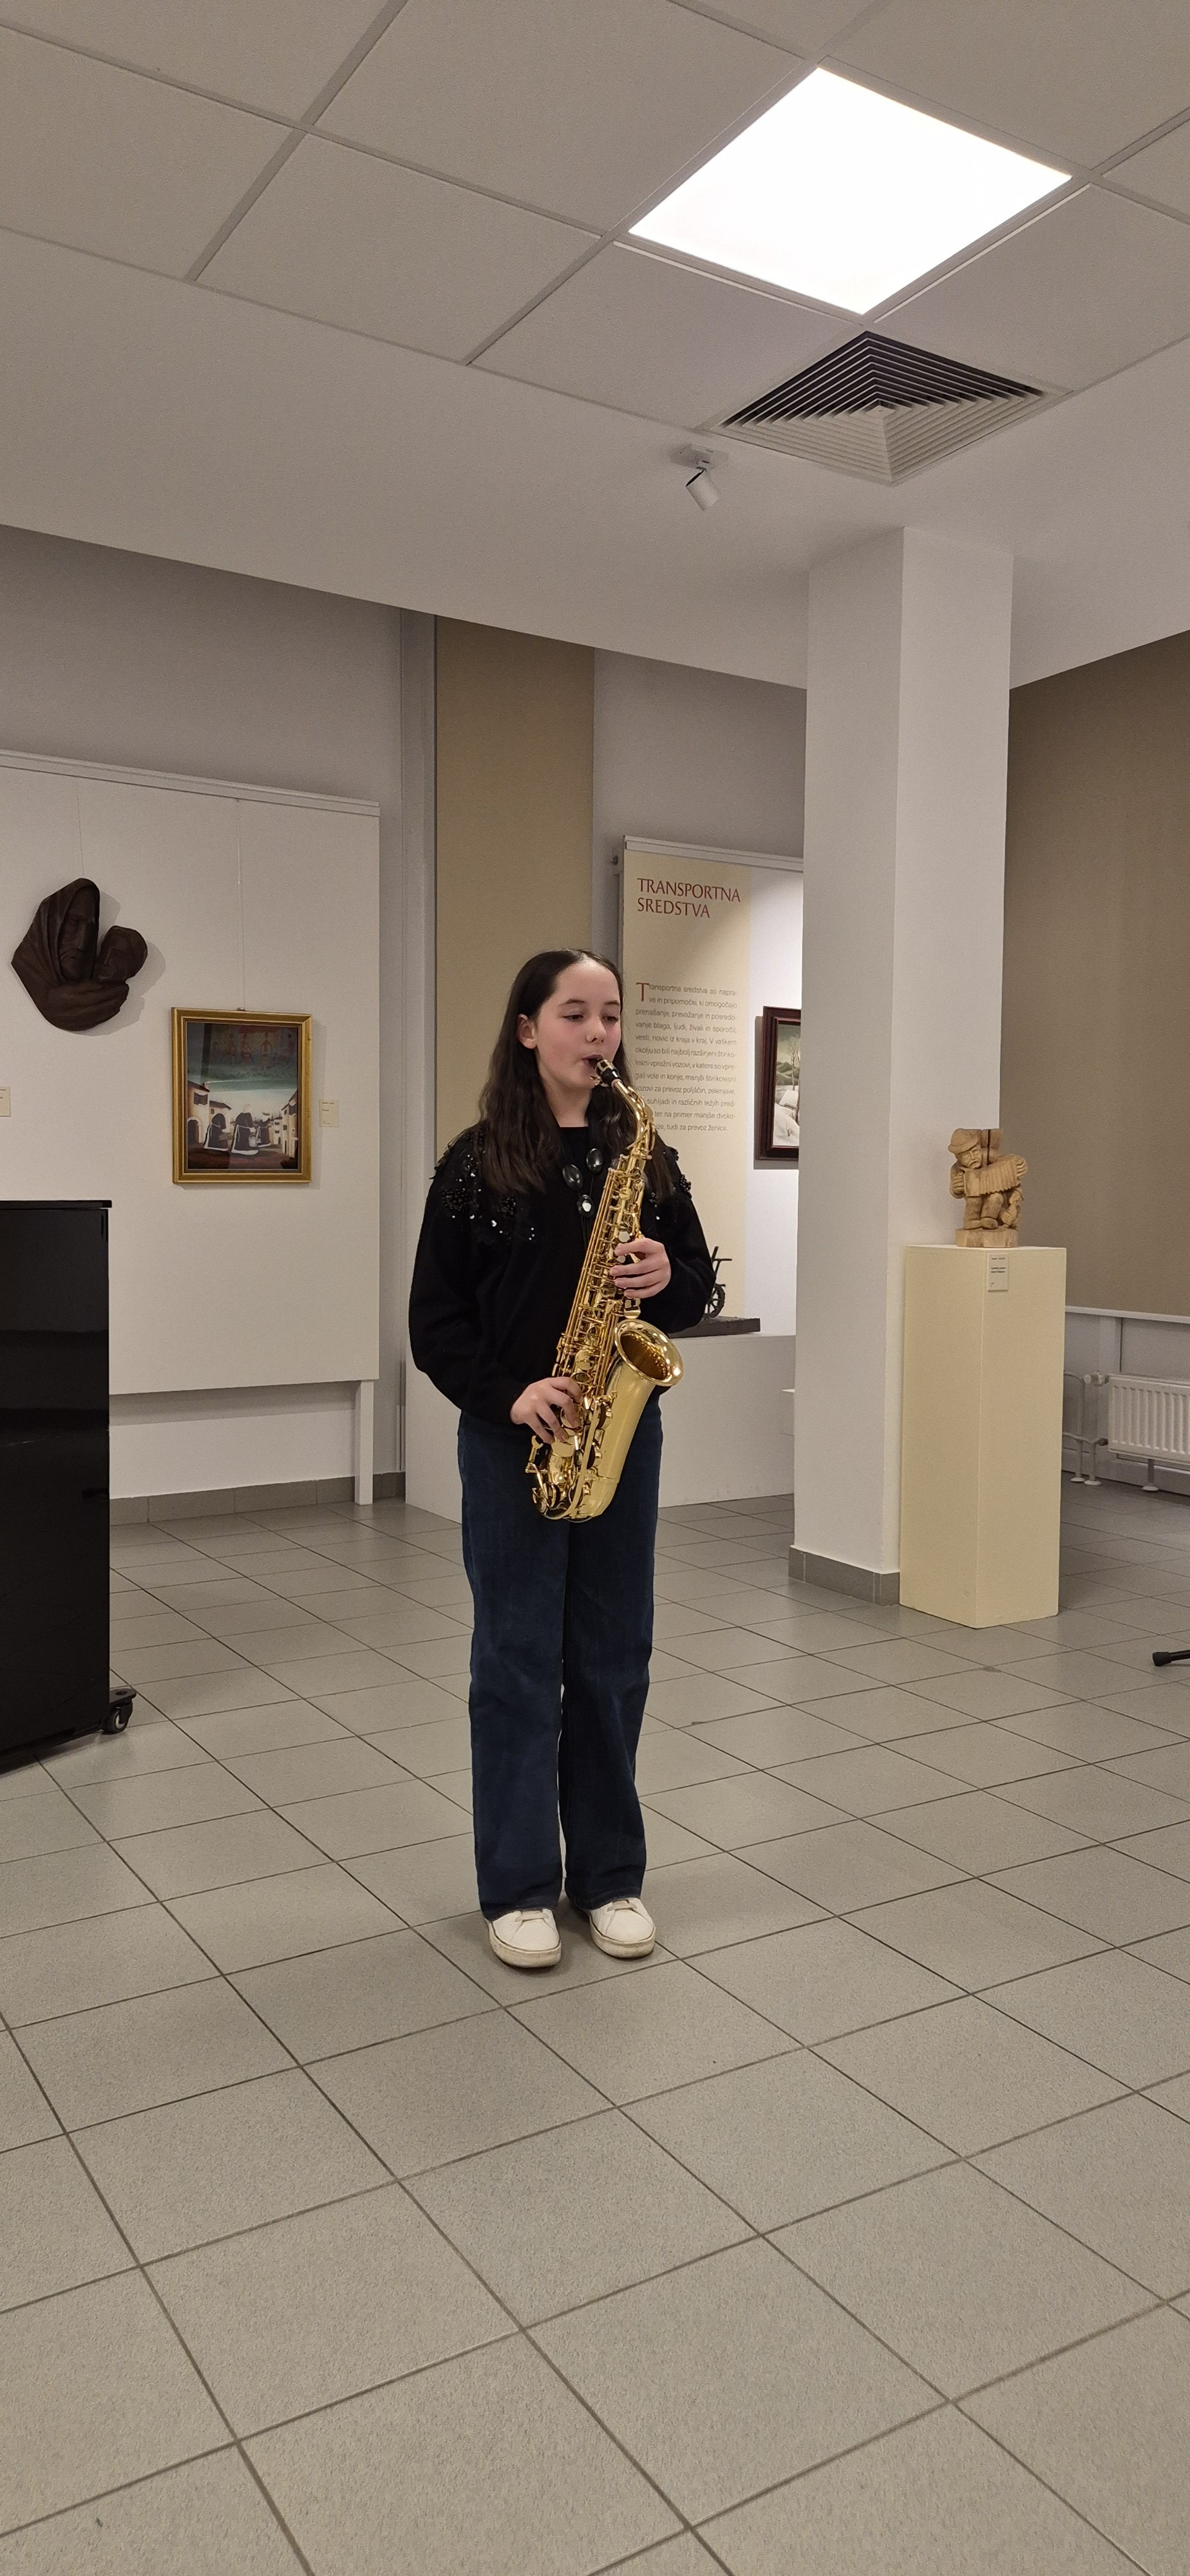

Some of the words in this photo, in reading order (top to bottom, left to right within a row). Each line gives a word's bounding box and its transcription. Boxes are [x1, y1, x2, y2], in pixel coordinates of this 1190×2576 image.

[637, 878, 741, 902] TRANSPORTNA
[638, 897, 710, 918] SREDSTVA
[636, 982, 681, 1001] Transportna
